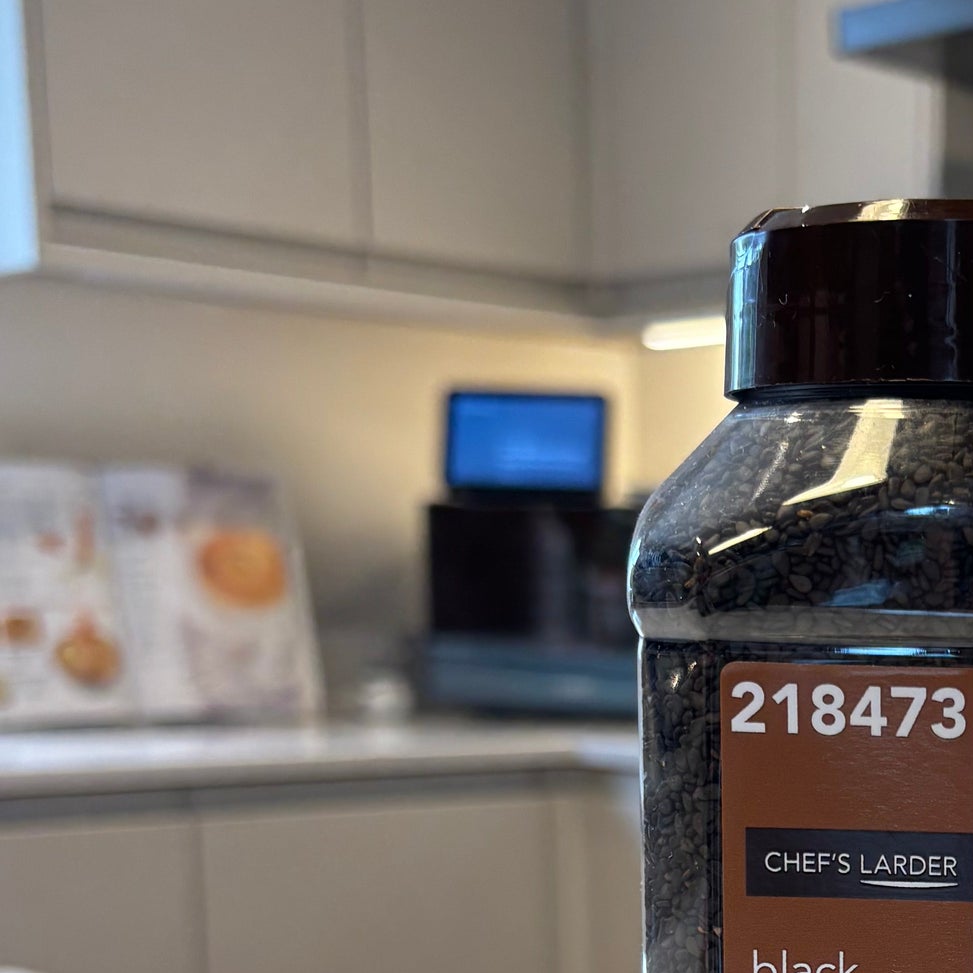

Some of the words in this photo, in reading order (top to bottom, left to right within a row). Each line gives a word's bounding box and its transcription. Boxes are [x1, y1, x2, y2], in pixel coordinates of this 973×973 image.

[731, 681, 966, 739] 218473
[764, 851, 852, 875] CHEF'S
[860, 853, 958, 877] LARDER
